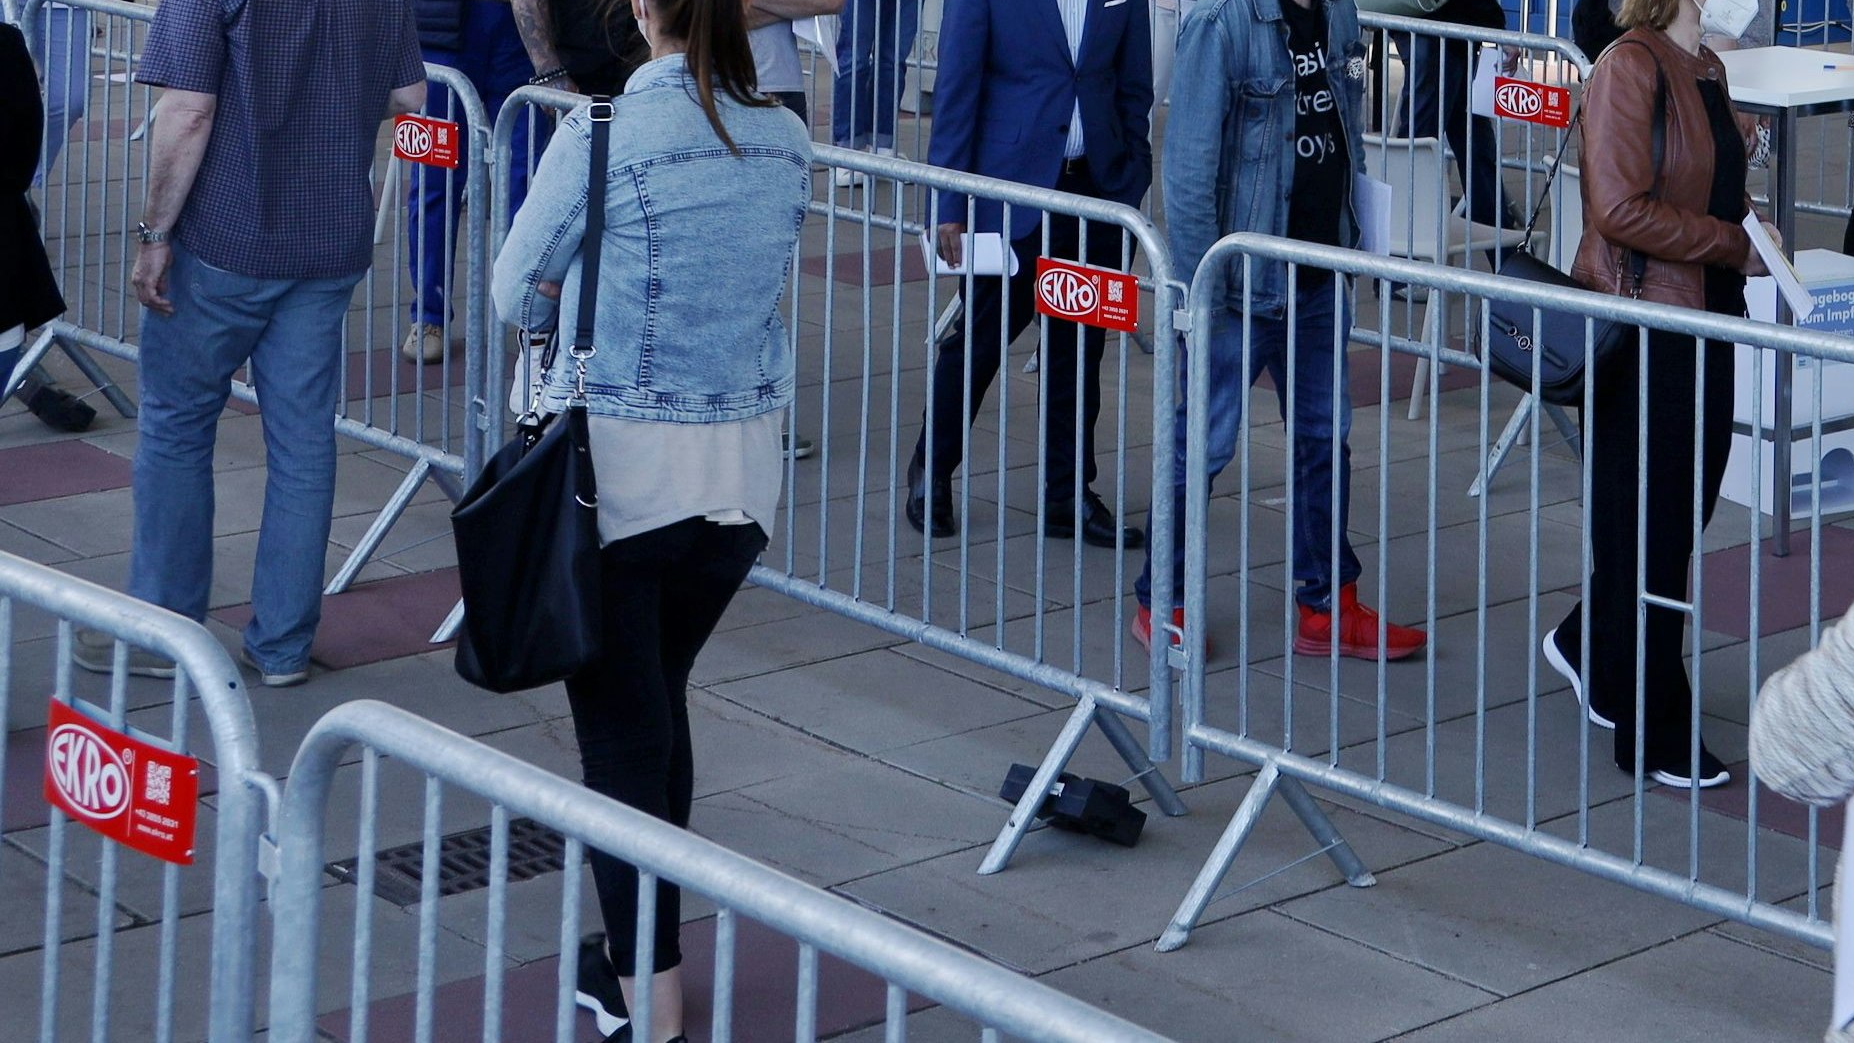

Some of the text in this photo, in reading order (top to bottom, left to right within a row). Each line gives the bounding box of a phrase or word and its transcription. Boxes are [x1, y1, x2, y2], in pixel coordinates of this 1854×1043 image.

[1498, 87, 1538, 113] EKRO
[397, 124, 429, 154] EKRO
[1042, 272, 1093, 311] EKRO
[53, 732, 122, 809] EKRO
